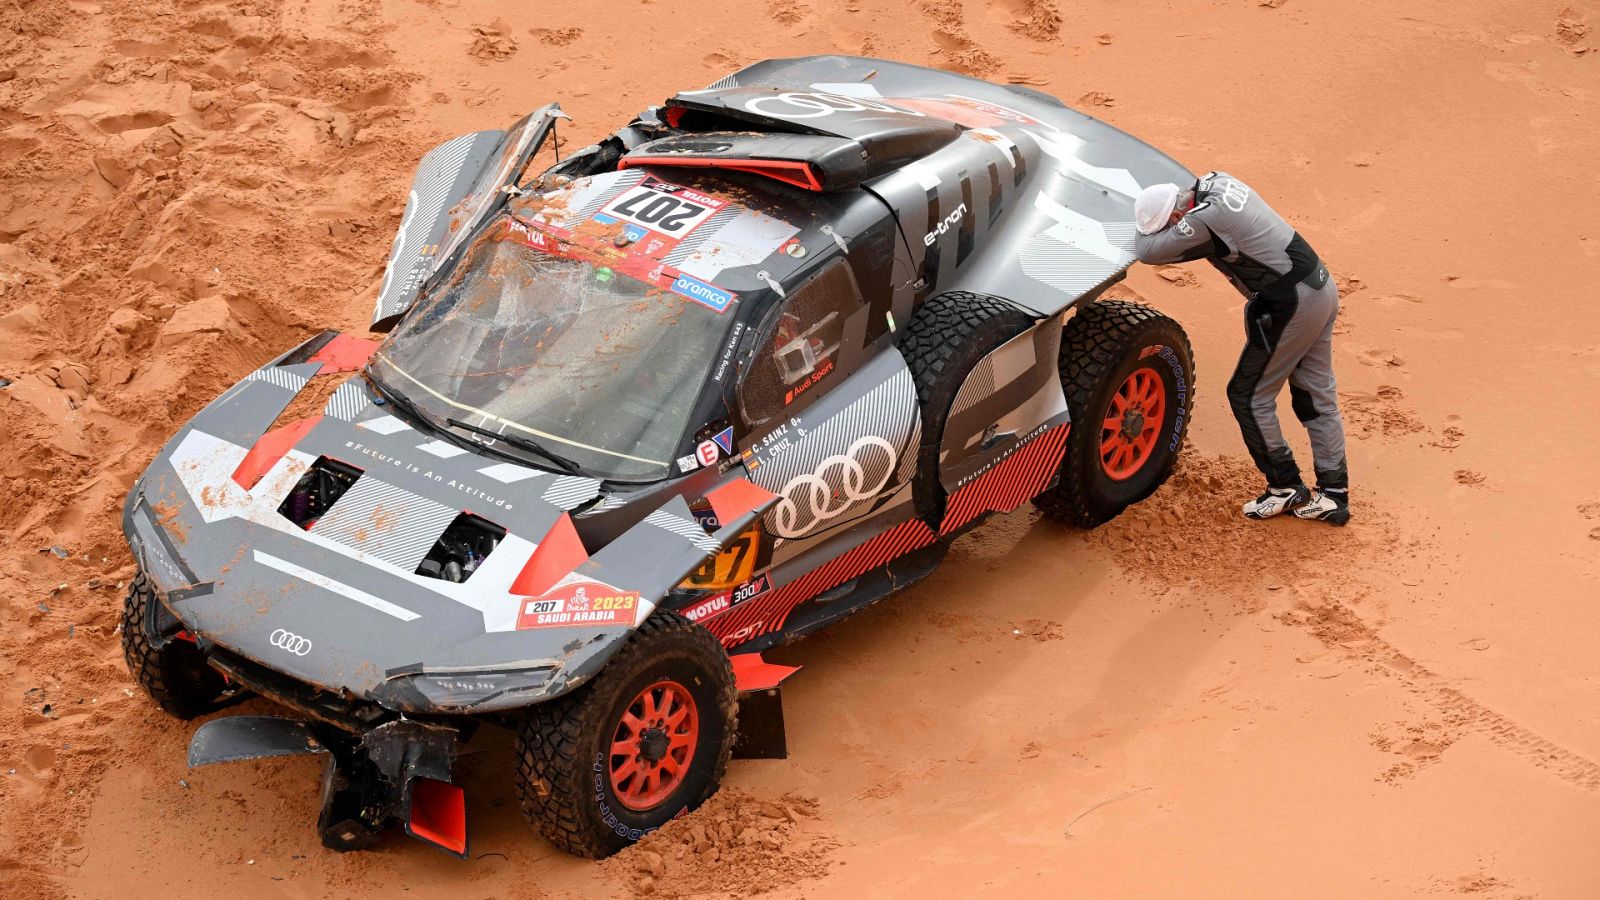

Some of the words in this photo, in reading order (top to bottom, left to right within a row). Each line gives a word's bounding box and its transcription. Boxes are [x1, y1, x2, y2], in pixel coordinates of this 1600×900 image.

[612, 191, 706, 232] 207
[681, 190, 722, 207] MOTUL
[924, 203, 967, 246] e-tron
[400, 268, 418, 295] SAINZ
[677, 278, 726, 305] aramco
[715, 359, 729, 380] Racing
[728, 336, 737, 348] Ken
[794, 378, 812, 396] Audi
[811, 362, 833, 383] Sport
[701, 443, 715, 463] E
[752, 443, 763, 454] C.
[762, 424, 789, 446] SAINZ
[757, 456, 770, 465] L.
[768, 438, 791, 456] CRUZ
[958, 463, 991, 487] #Future
[993, 456, 1001, 464] Is
[1003, 448, 1013, 458] An
[1015, 424, 1048, 449] Attitude
[345, 441, 402, 466] #Future
[406, 463, 419, 473] Is
[424, 471, 443, 482] An
[448, 479, 513, 510] Attitude
[533, 601, 557, 613] 207
[592, 596, 634, 611] 2023
[686, 596, 729, 620] MOTUL
[734, 577, 764, 603] 300V
[537, 612, 571, 624] SAUDI
[573, 610, 615, 622] ARABIA
